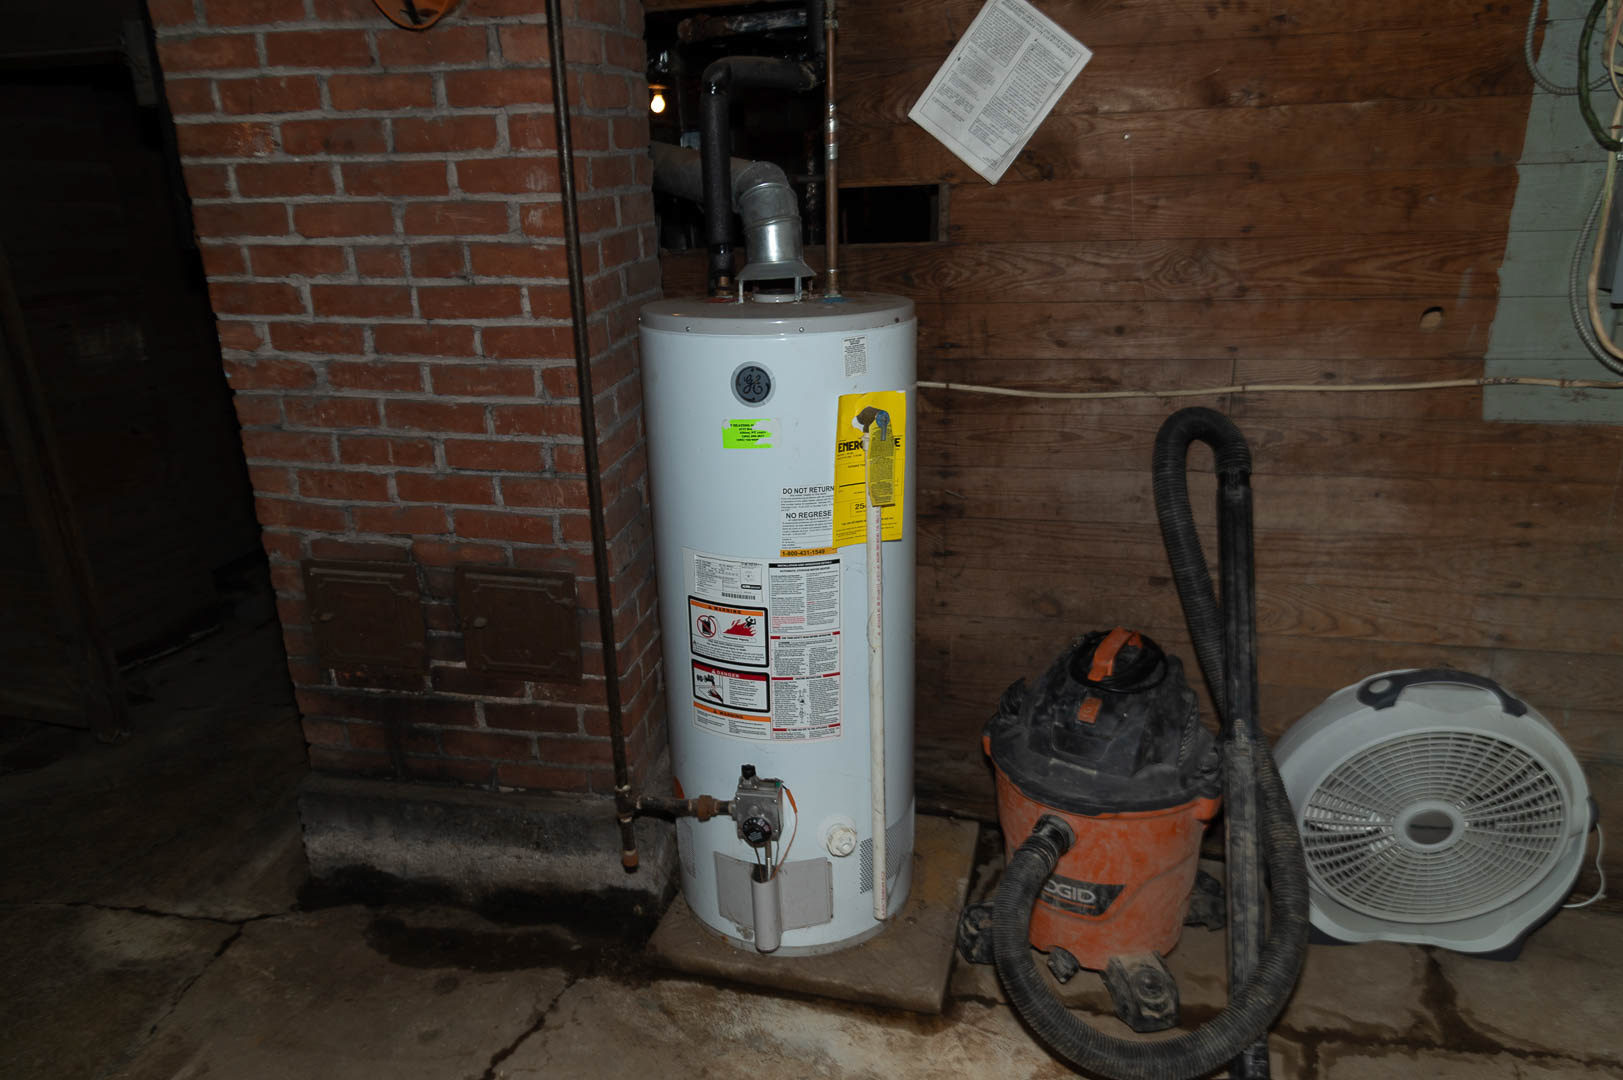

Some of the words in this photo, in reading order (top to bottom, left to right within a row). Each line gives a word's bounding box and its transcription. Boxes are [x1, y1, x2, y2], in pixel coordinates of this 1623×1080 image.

[782, 487, 793, 495] DO
[809, 485, 834, 493] RETURN
[855, 502, 867, 510] 25
[798, 509, 832, 519] REGRESE
[716, 670, 740, 678] DANGER
[1044, 879, 1097, 904] DGID
